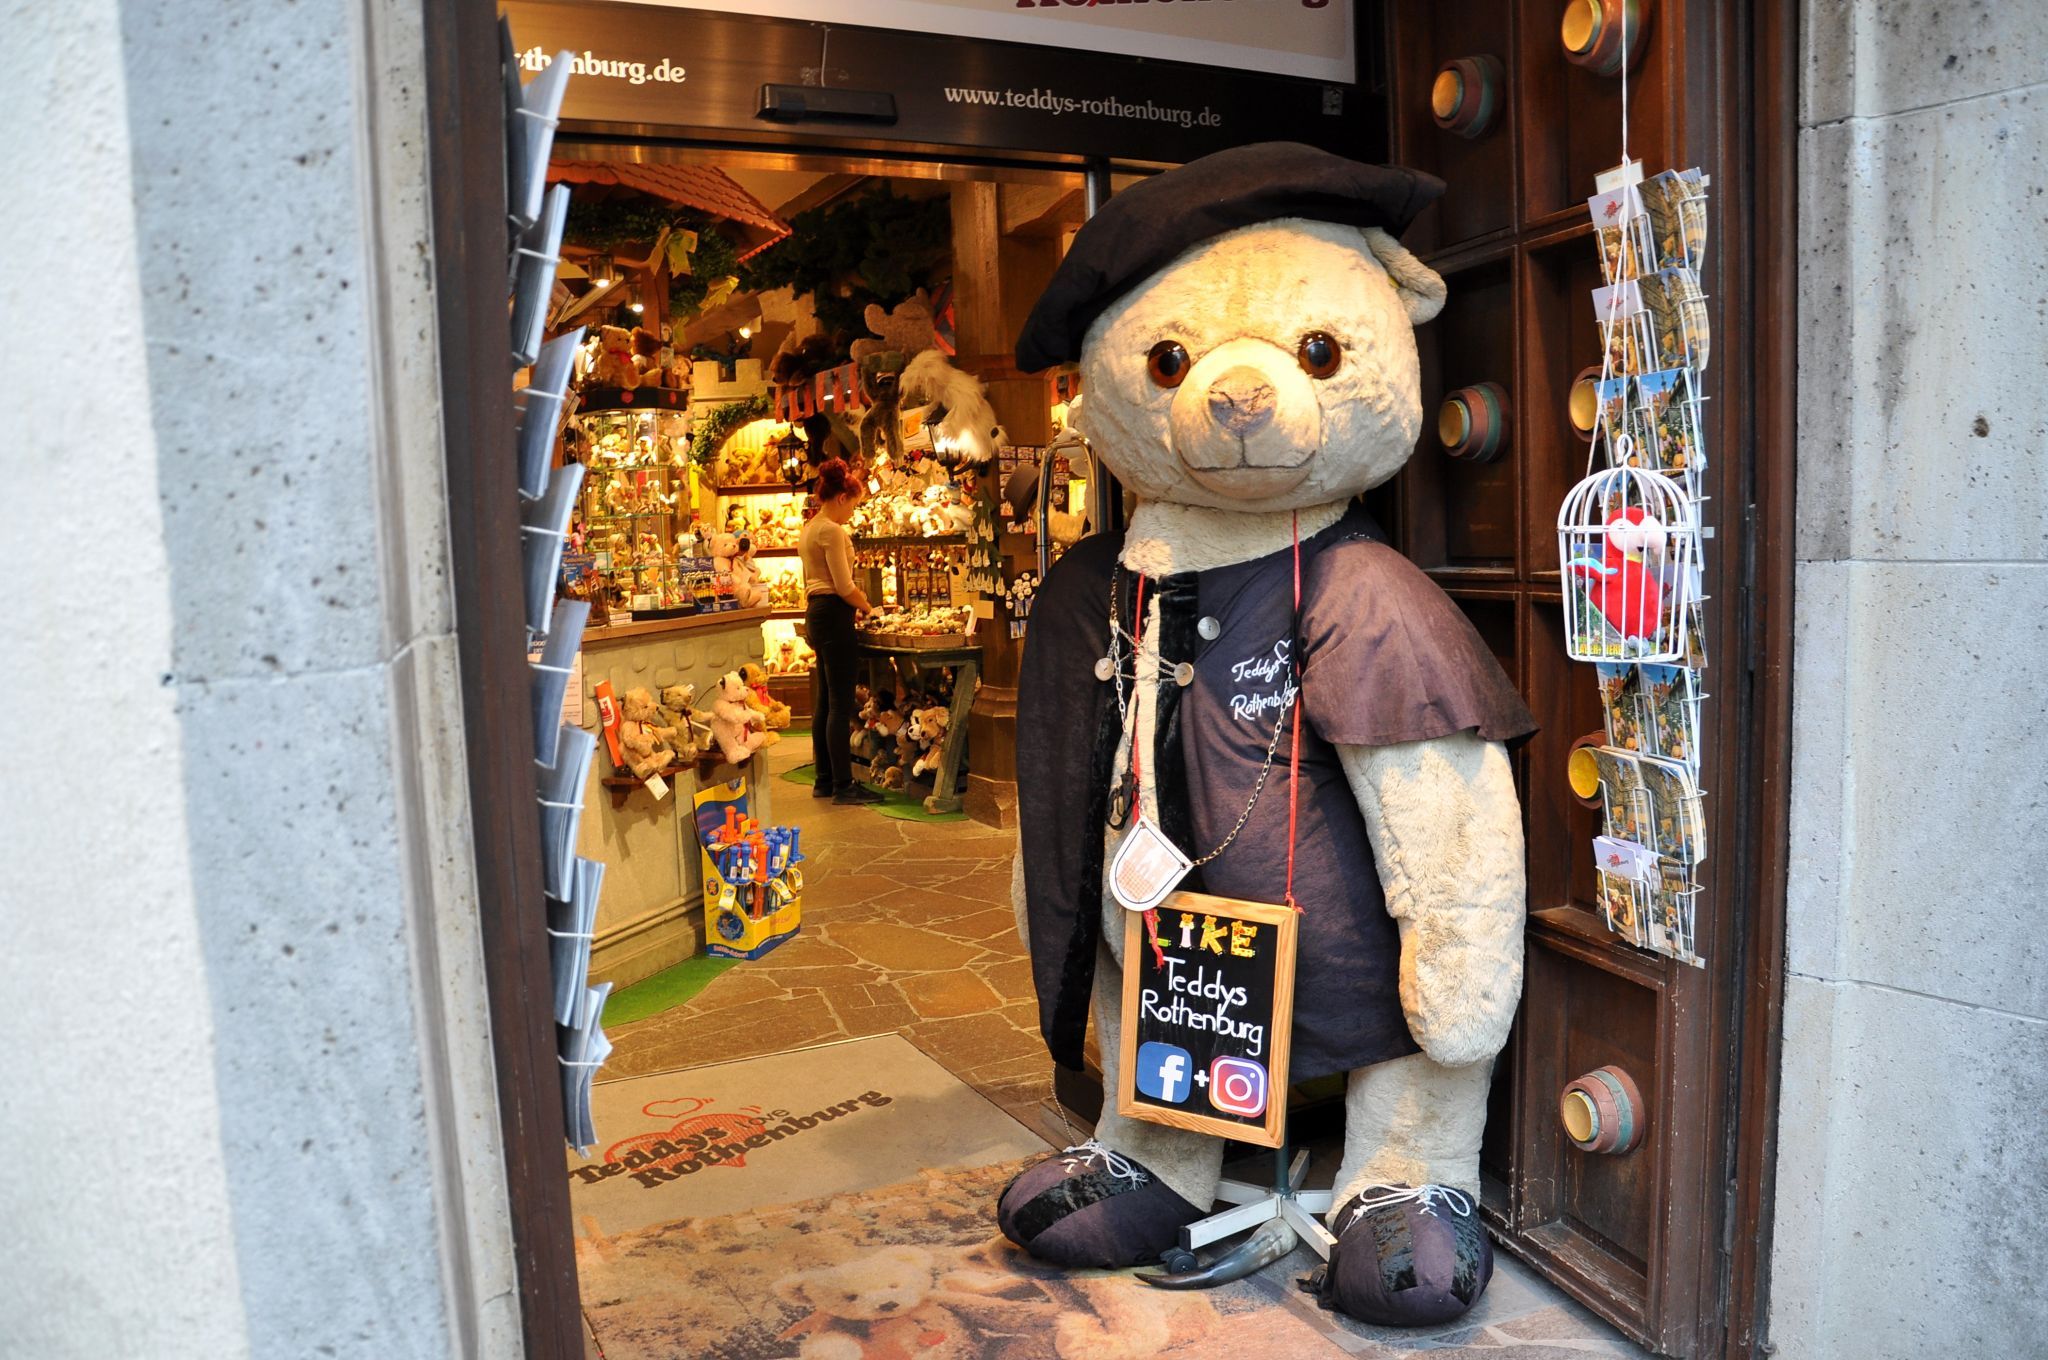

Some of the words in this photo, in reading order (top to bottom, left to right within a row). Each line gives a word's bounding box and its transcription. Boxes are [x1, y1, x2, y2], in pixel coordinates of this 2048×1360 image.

[944, 86, 1222, 128] www.teddys-rothenburg.de
[1231, 656, 1280, 683] Teddys
[1163, 955, 1247, 1013] Teddys
[1141, 988, 1263, 1056] Rothenburg
[569, 1127, 728, 1185] Teddys
[628, 1090, 893, 1189] Rothenburg
